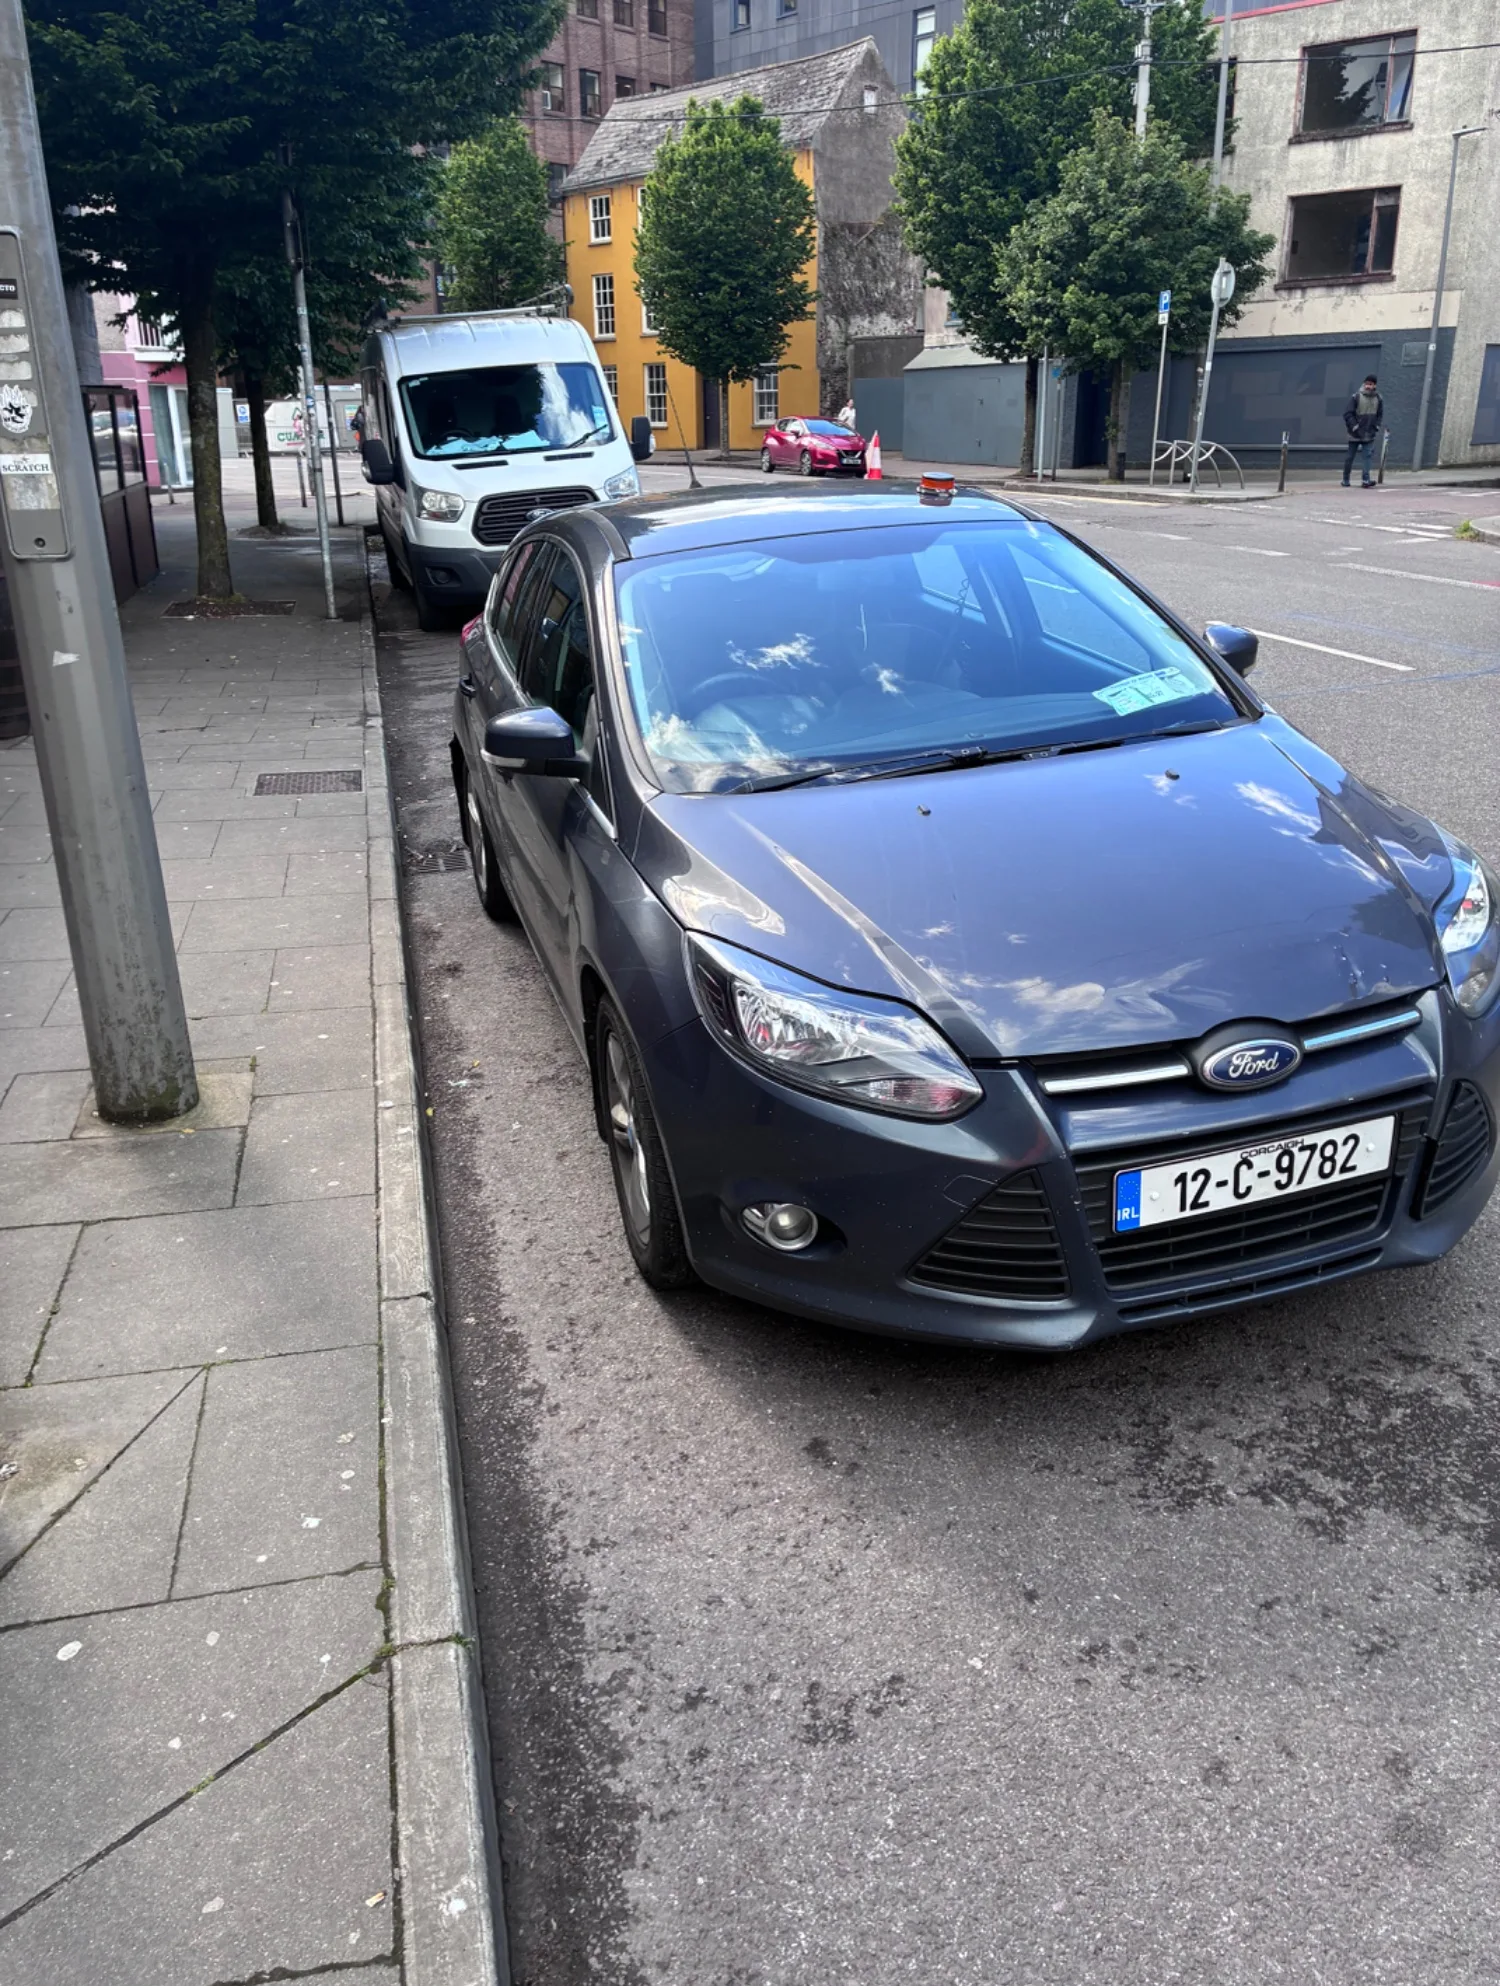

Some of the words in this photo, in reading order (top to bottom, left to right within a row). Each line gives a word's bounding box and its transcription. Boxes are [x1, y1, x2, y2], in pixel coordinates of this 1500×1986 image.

[1162, 293, 1168, 311] P
[2, 464, 50, 472] SCRATCH
[1229, 1049, 1279, 1078] Ford
[1240, 1138, 1305, 1159] CORCAIGH
[1174, 1133, 1361, 1212] 12-C-9782
[1117, 1206, 1140, 1221] IRL
